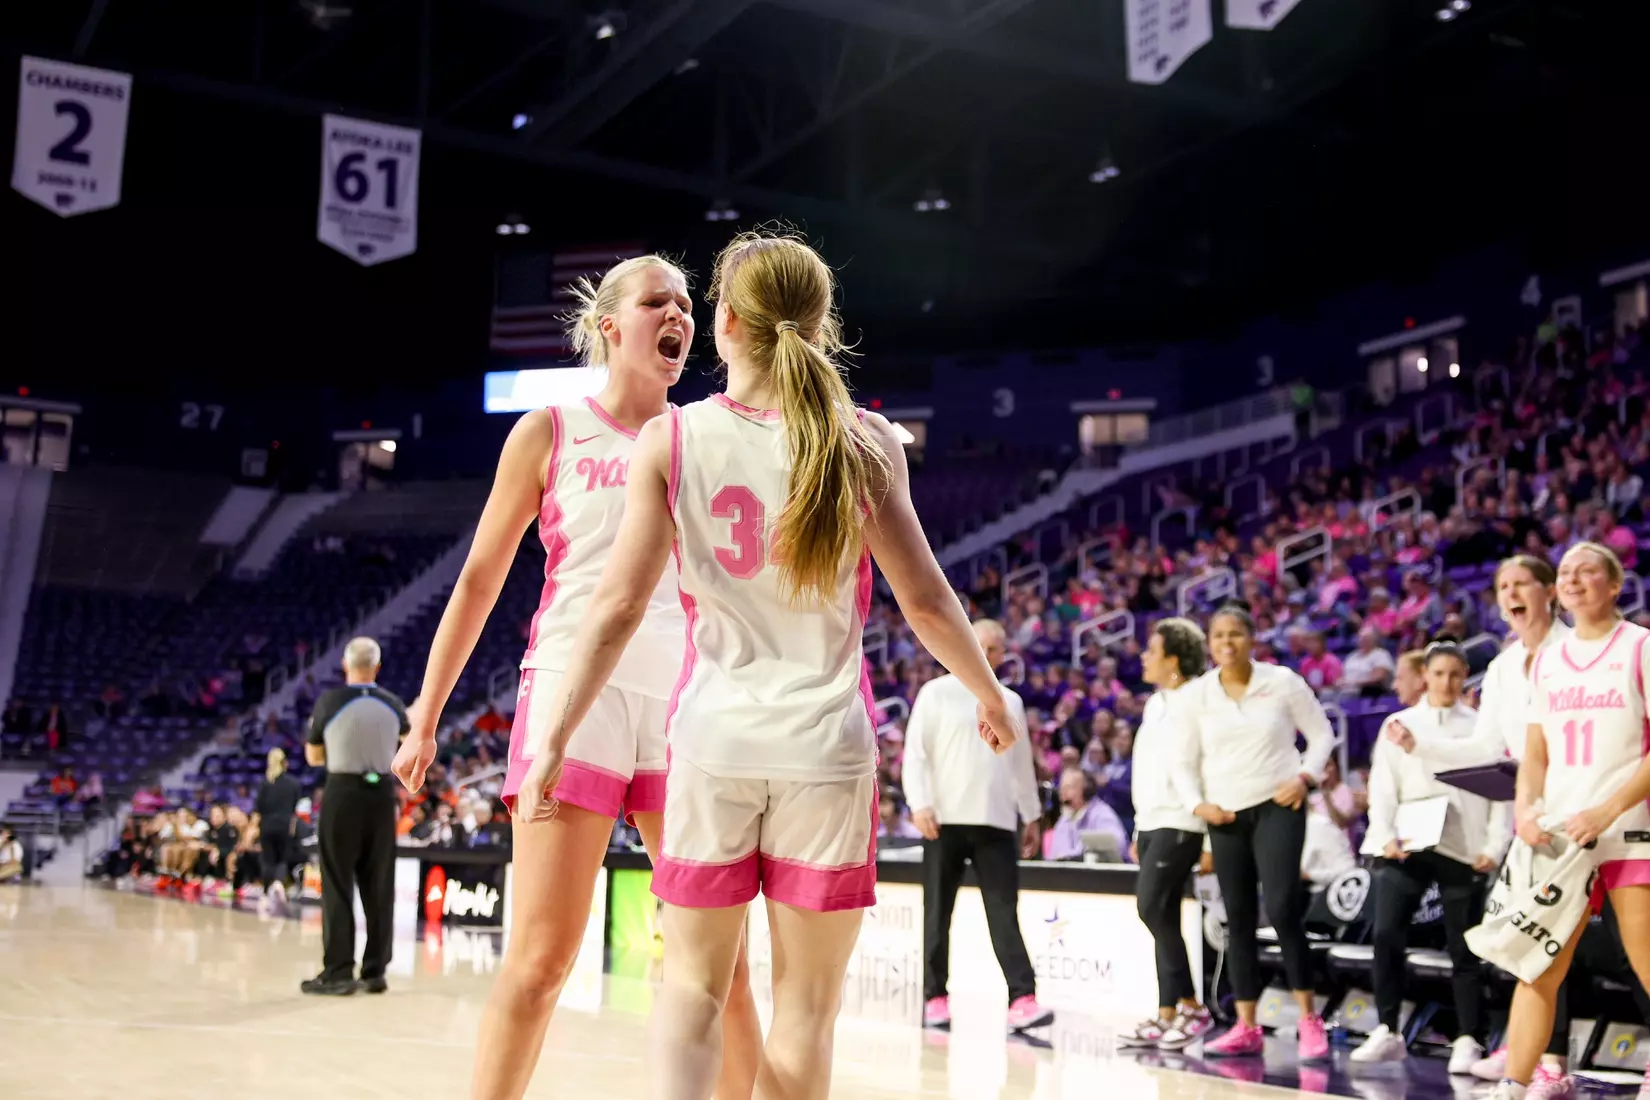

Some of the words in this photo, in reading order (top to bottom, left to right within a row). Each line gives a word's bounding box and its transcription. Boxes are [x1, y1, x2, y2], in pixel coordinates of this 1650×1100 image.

[27, 69, 125, 101] CHAMBERS
[49, 98, 93, 167] 2
[335, 152, 398, 209] 61
[180, 401, 225, 431] 27
[992, 387, 1015, 418] 3
[710, 485, 788, 579] 3
[1548, 686, 1626, 713] Wildcats
[1563, 720, 1593, 766] 11
[1035, 954, 1113, 984] EEDOM
